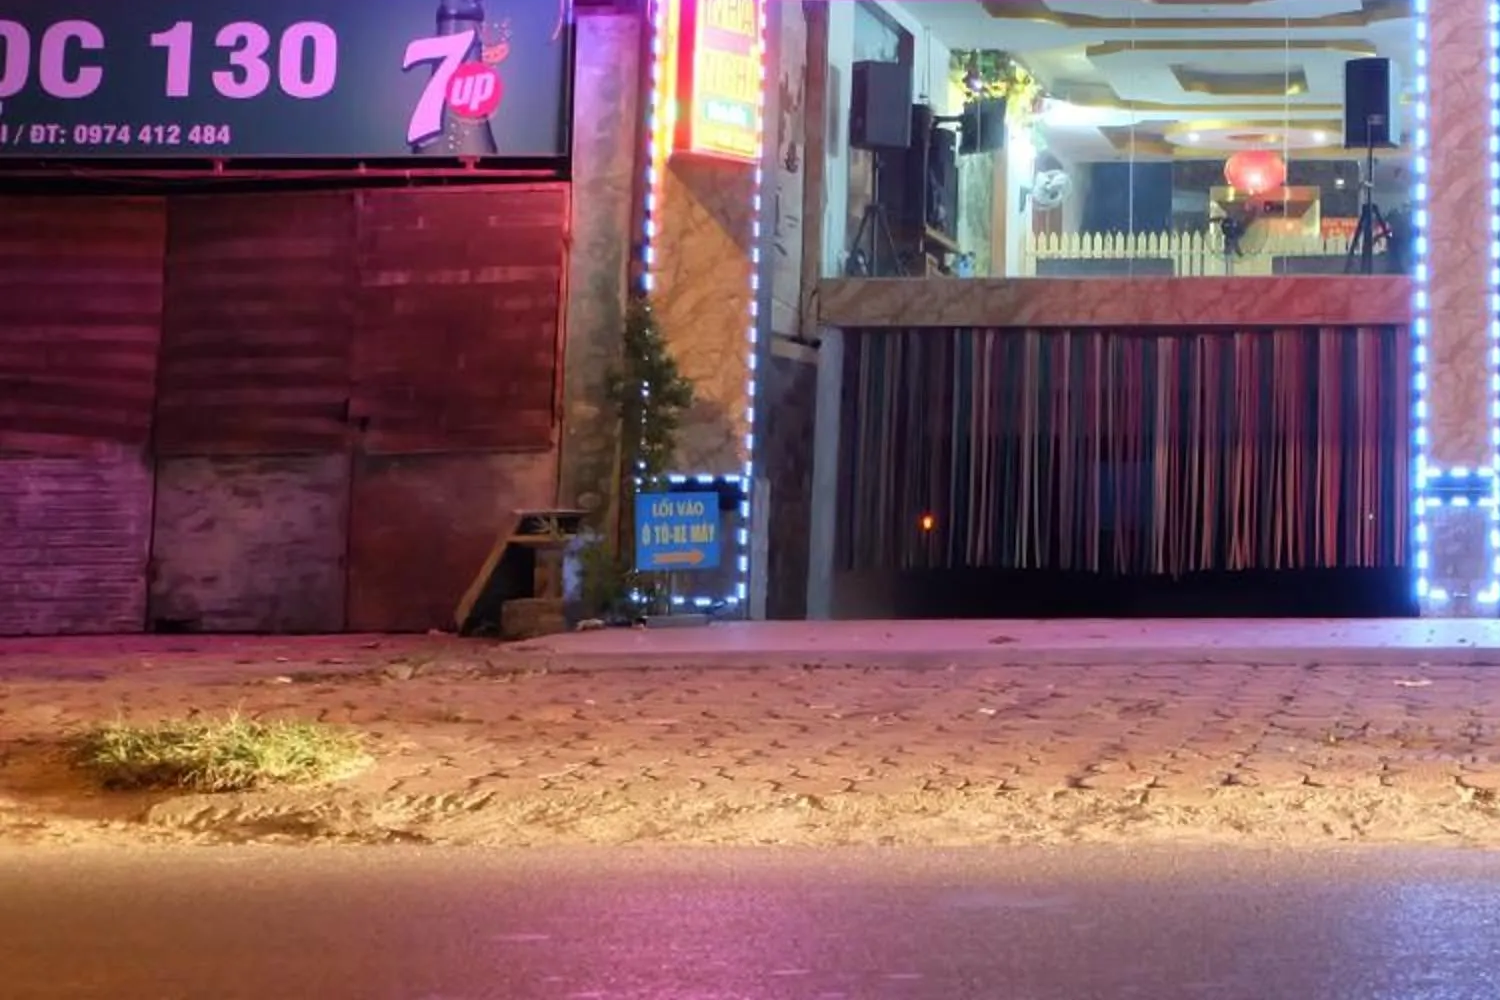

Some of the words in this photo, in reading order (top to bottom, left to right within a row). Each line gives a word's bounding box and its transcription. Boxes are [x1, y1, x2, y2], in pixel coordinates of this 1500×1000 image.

[150, 20, 338, 99] 130
[74, 125, 131, 144] 0974
[138, 125, 181, 144] 412
[187, 125, 231, 144] 484
